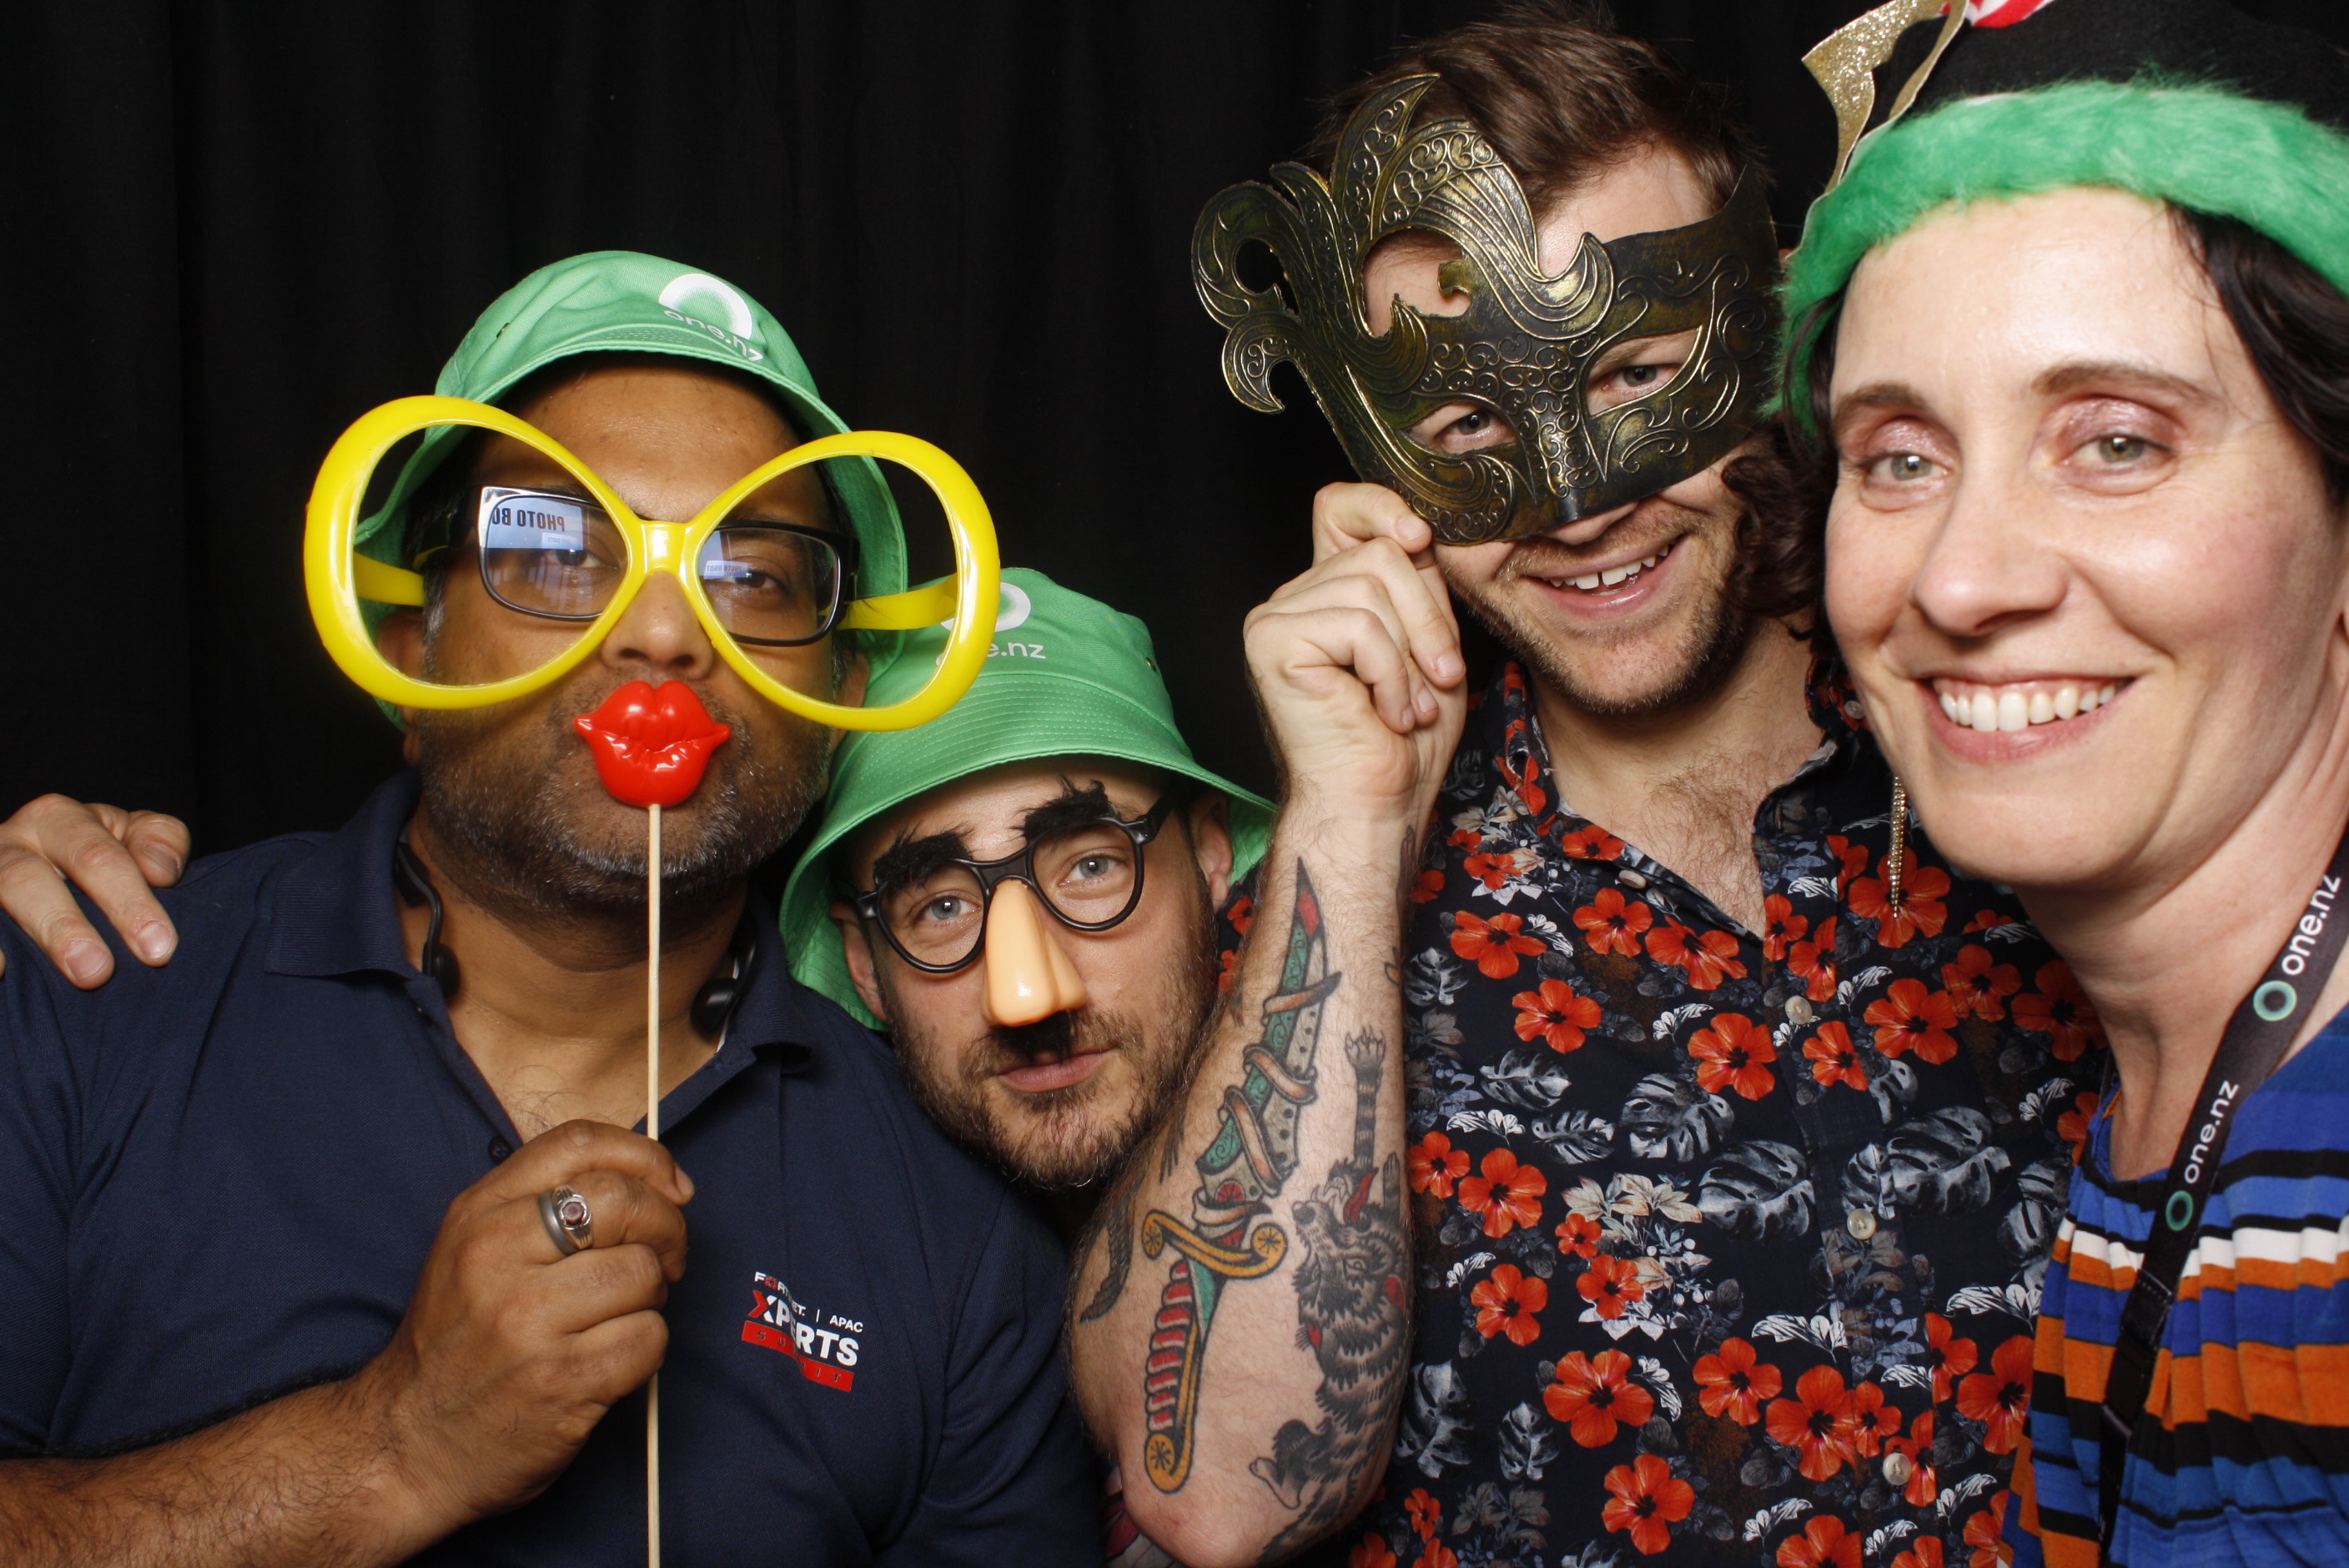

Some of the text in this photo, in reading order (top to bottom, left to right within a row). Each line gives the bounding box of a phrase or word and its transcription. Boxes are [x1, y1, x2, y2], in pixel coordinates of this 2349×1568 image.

[663, 309, 764, 362] one.nz
[2281, 873, 2341, 976] one.nz
[2184, 1080, 2239, 1184] one.nz
[829, 1314, 864, 1333] APAC
